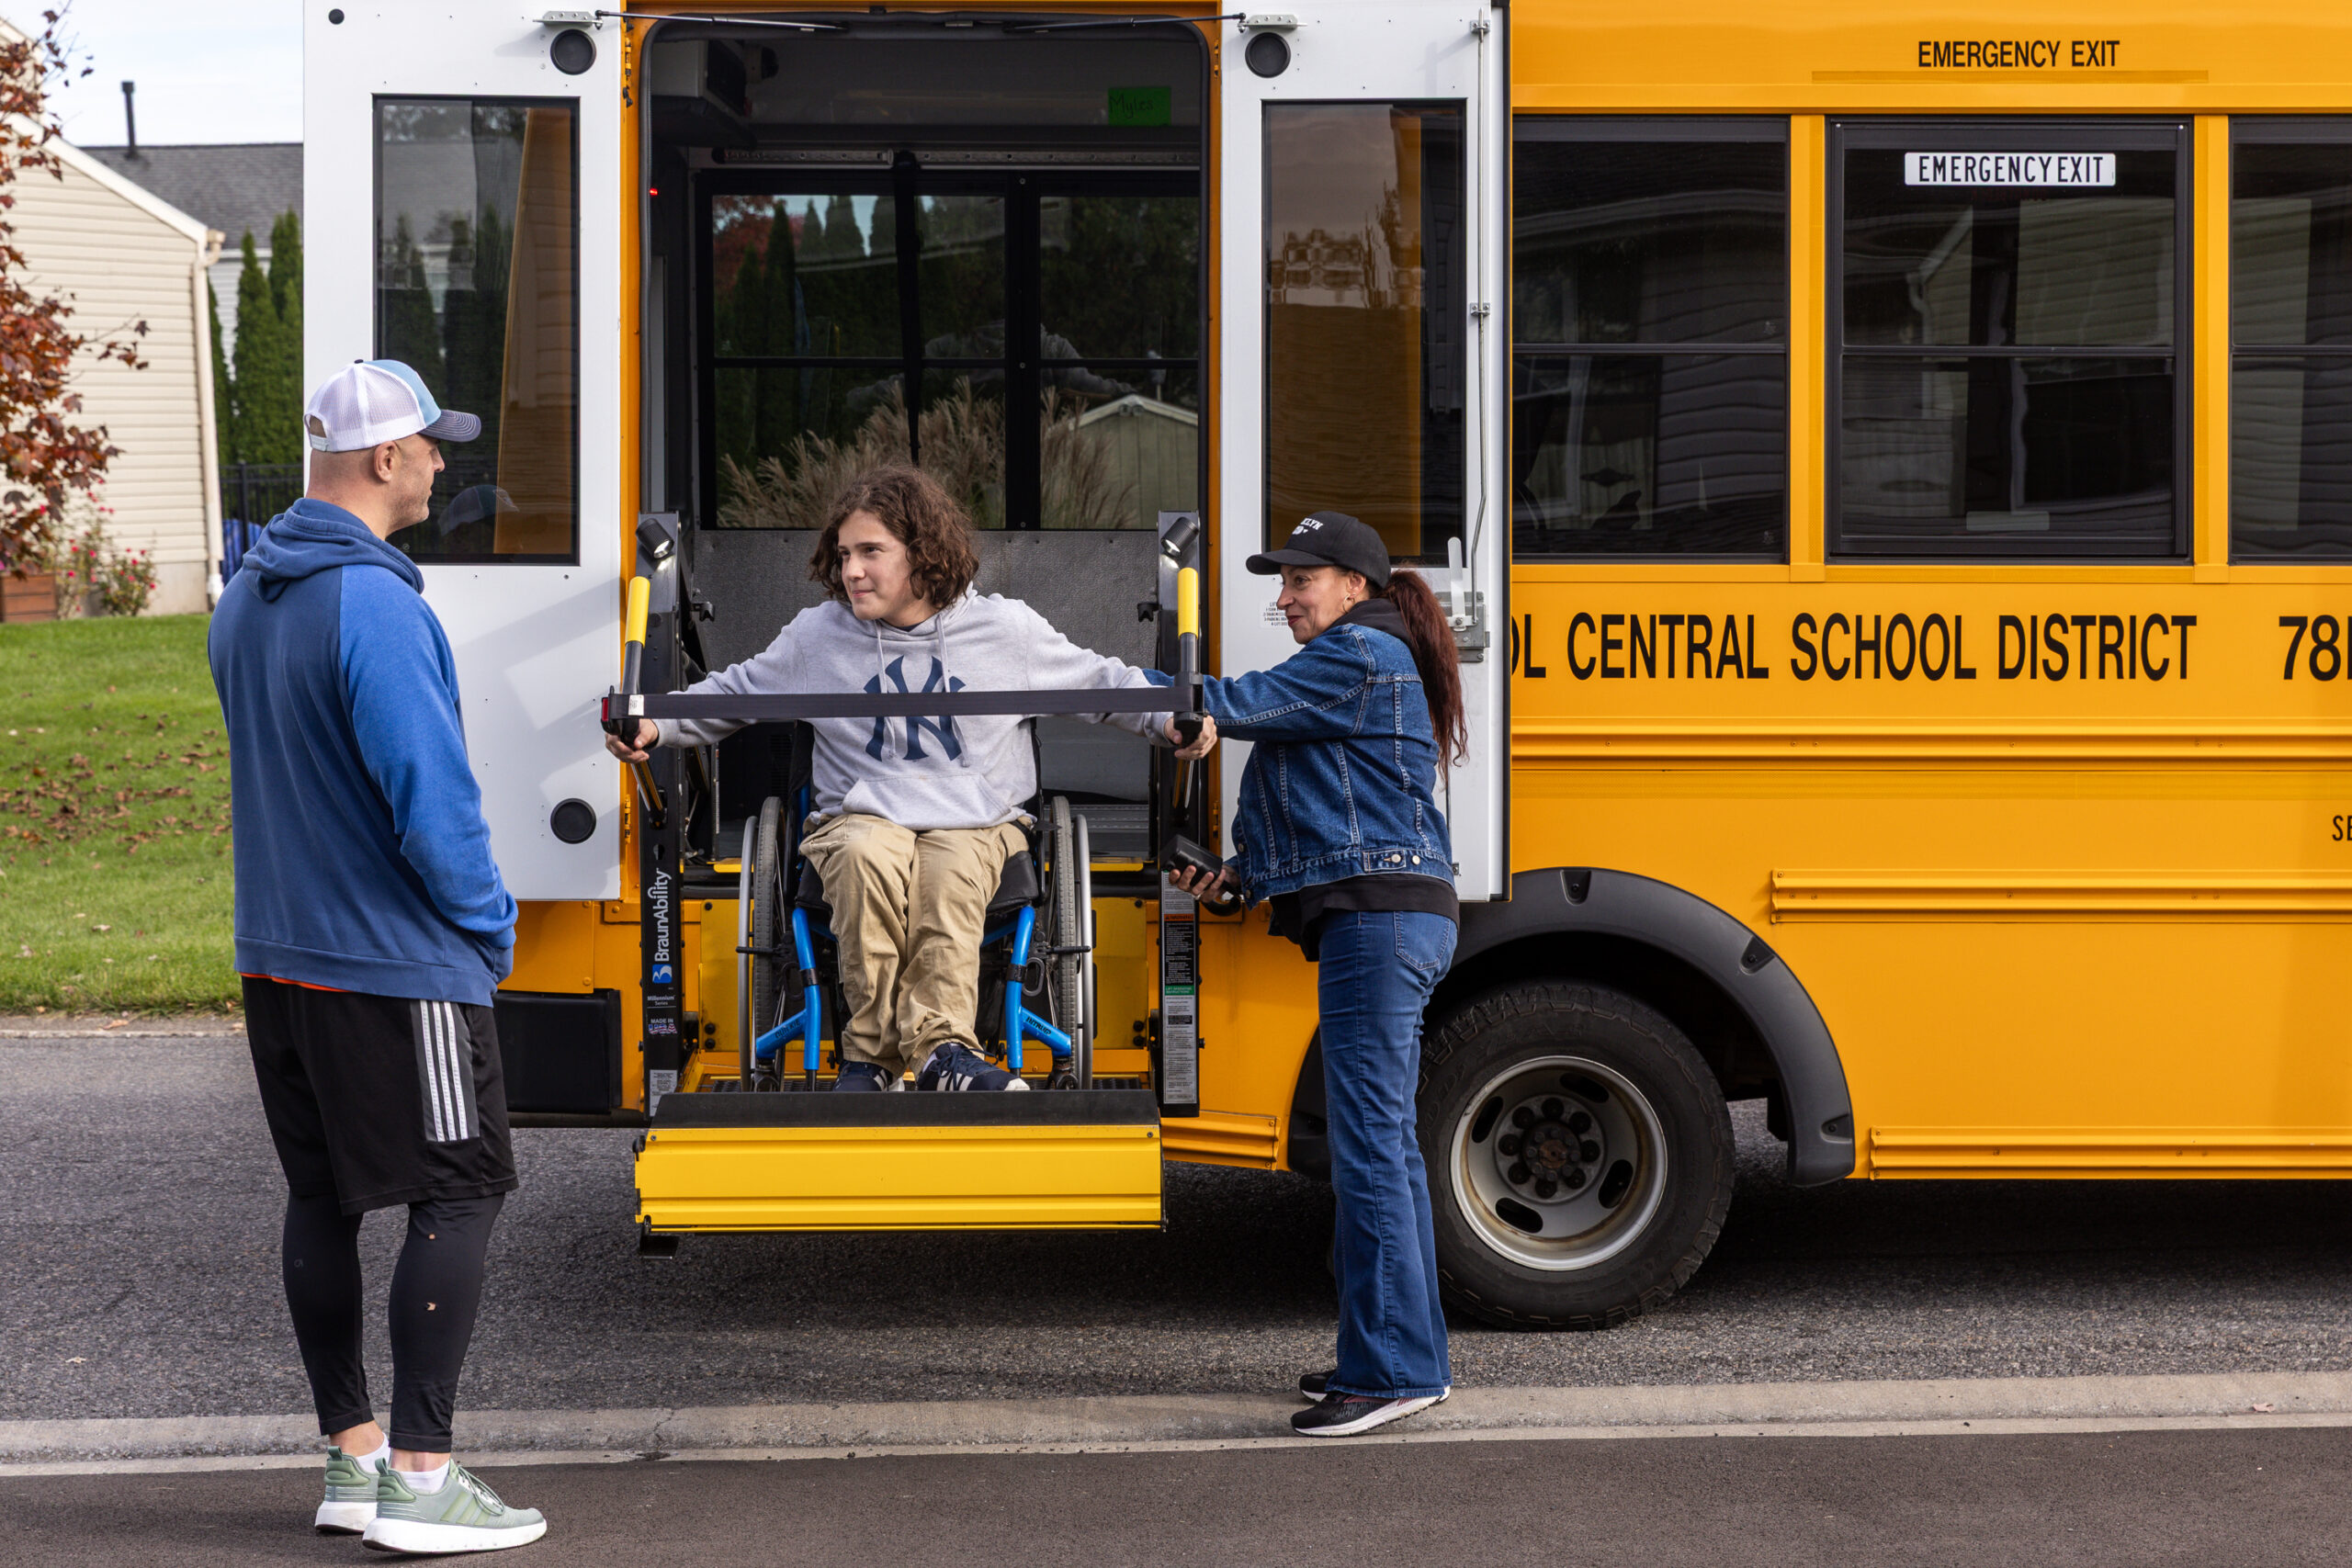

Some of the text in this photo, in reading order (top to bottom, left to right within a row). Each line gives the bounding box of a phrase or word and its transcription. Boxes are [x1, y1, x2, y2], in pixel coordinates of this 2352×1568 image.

[1918, 39, 2120, 68] EMERGENCY EXIT
[1109, 93, 1154, 119] Myles
[1918, 155, 2104, 184] EMERGENCY EXIT
[1566, 612, 1770, 681] CENTRAL
[1791, 613, 1977, 681] SCHOOL
[1998, 613, 2198, 682] DISTRICT
[864, 655, 967, 762] NY
[647, 869, 673, 962] BraunAbility
